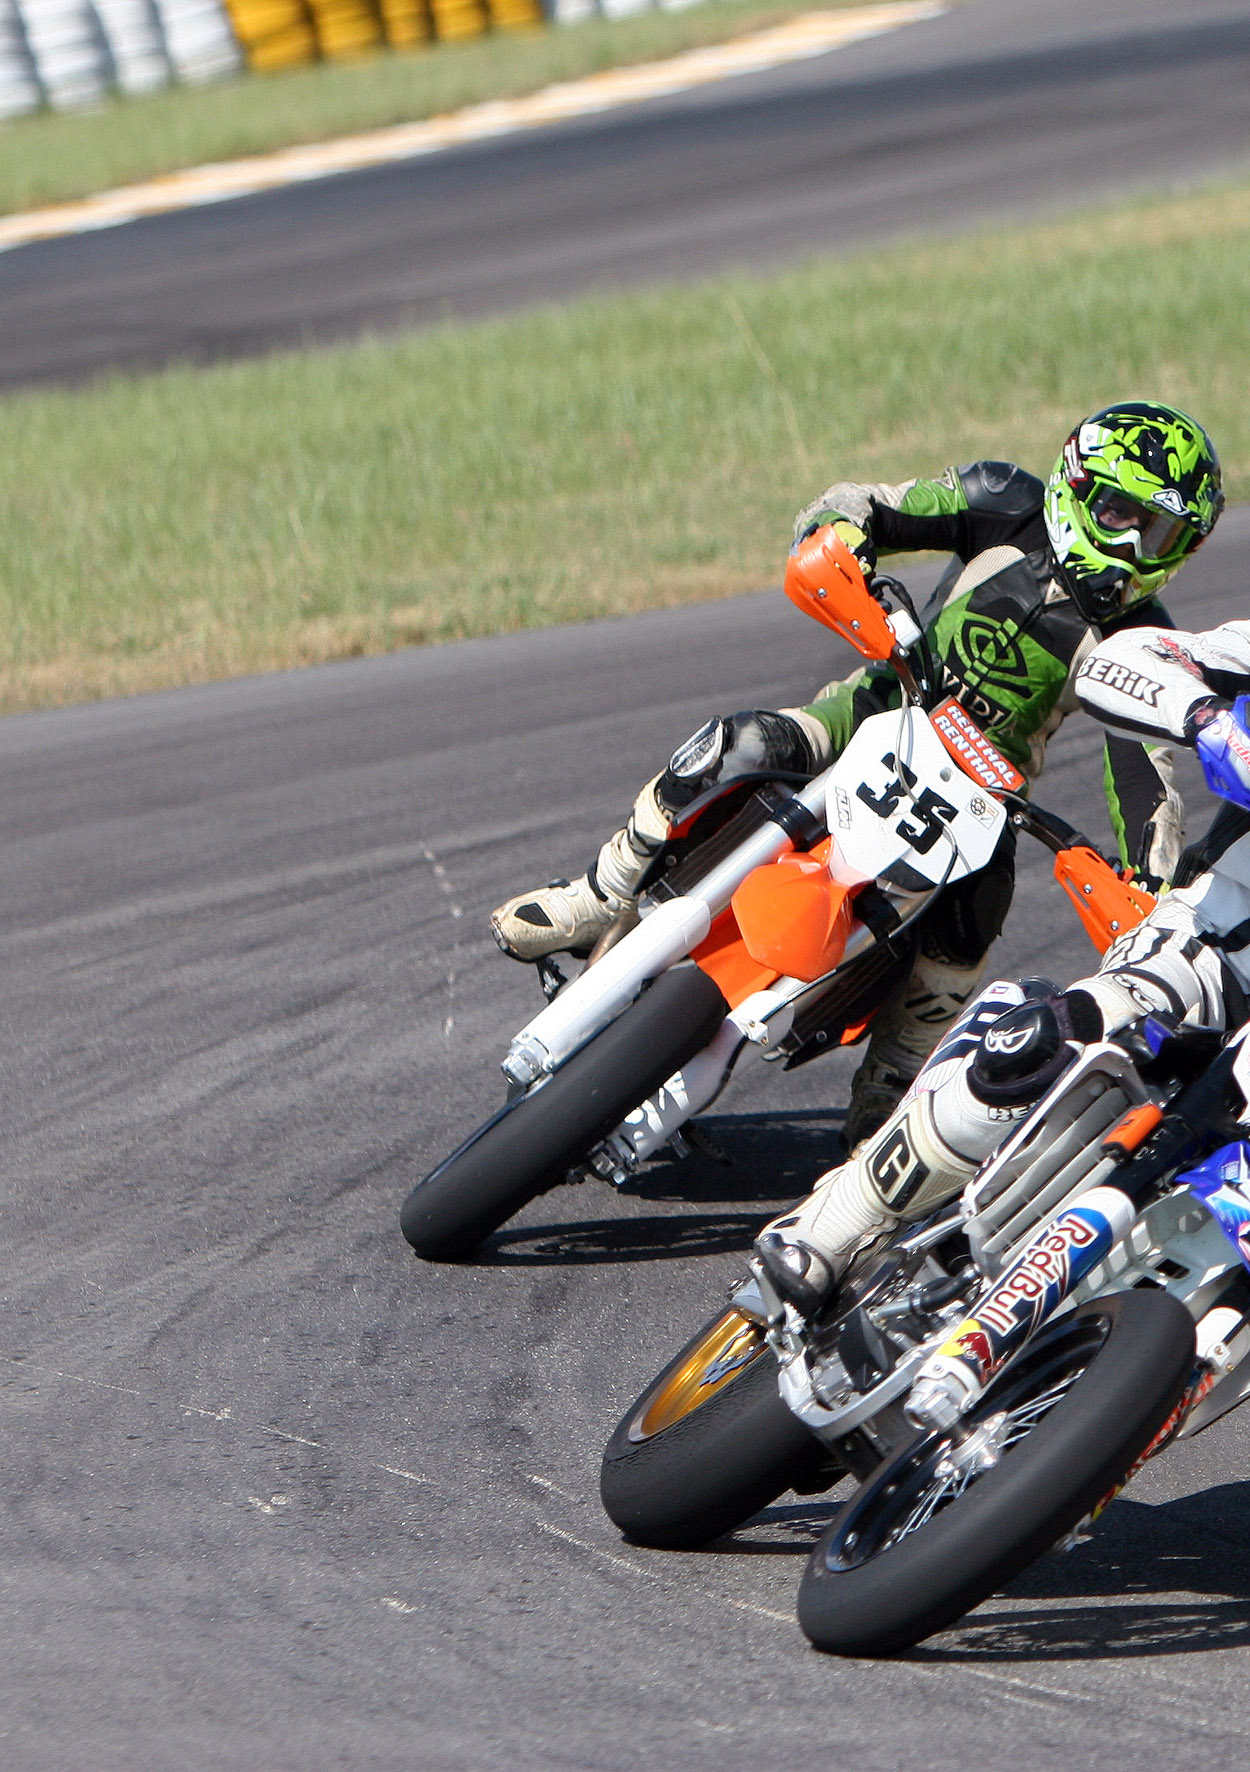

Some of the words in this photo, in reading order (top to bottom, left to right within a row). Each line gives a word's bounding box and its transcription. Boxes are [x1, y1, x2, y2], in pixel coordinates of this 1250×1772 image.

[947, 705, 1017, 785] RENTHAL
[835, 786, 852, 829] KTM
[856, 752, 959, 854] 35
[1024, 1213, 1099, 1285] Red
[975, 1266, 1048, 1338] Bull
